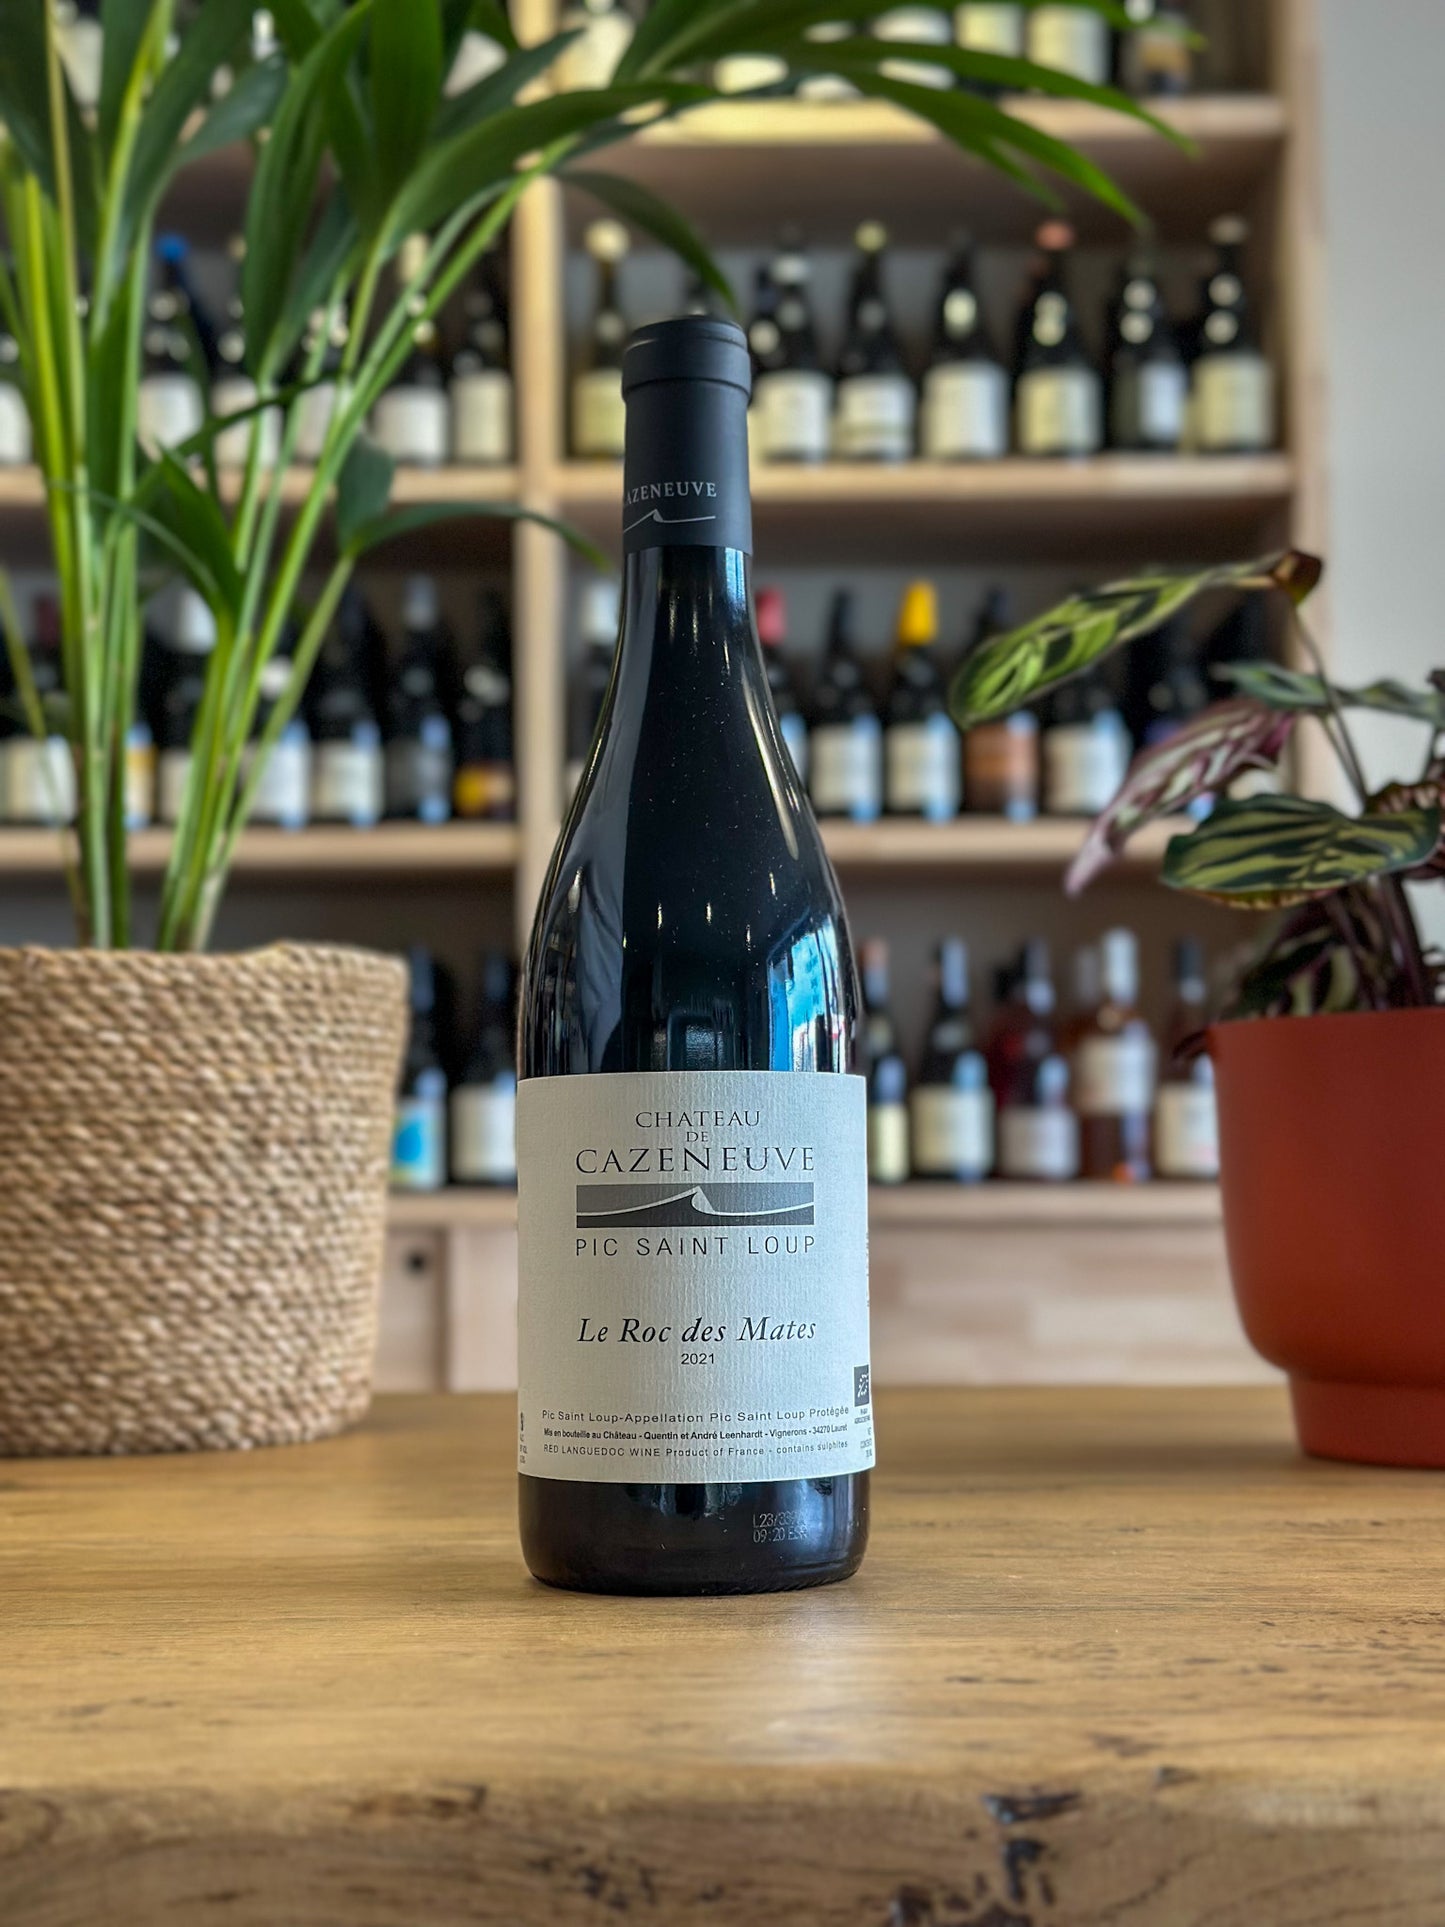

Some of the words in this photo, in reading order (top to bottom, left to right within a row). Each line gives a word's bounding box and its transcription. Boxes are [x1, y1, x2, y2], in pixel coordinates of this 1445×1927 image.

[624, 481, 717, 505] AZENEUVE
[635, 1110, 761, 1128] CHATEAU
[685, 1131, 709, 1142] DE
[576, 1147, 815, 1173] CAZENEUVE
[575, 1238, 618, 1256] PIC
[636, 1237, 729, 1255] SAINT
[748, 1236, 815, 1254] LOUP
[577, 1318, 608, 1343] Le
[617, 1318, 672, 1343] Roc
[681, 1316, 726, 1343] des
[736, 1316, 817, 1341] Mates
[680, 1353, 715, 1365] 2021
[542, 1410, 555, 1420] Pic
[558, 1411, 584, 1421] Saint
[589, 1412, 703, 1424] Loup-Appellation
[710, 1412, 732, 1422] Pic
[737, 1411, 771, 1422] Saint
[777, 1410, 806, 1420] Loup
[809, 1406, 849, 1417] Protégée
[603, 1431, 637, 1440] Château
[643, 1432, 678, 1441] Quentin
[680, 1432, 689, 1440] et
[691, 1432, 718, 1440] André
[720, 1430, 763, 1439] Leenhardt
[769, 1429, 807, 1439] Vignerons
[544, 1444, 559, 1453] RED
[562, 1445, 625, 1456] LANGUEDOC
[629, 1448, 660, 1457] WINE
[666, 1447, 708, 1457] Product
[713, 1448, 724, 1456] of
[728, 1447, 764, 1456] France
[776, 1443, 814, 1454] contains
[753, 1527, 786, 1543] 09:20
